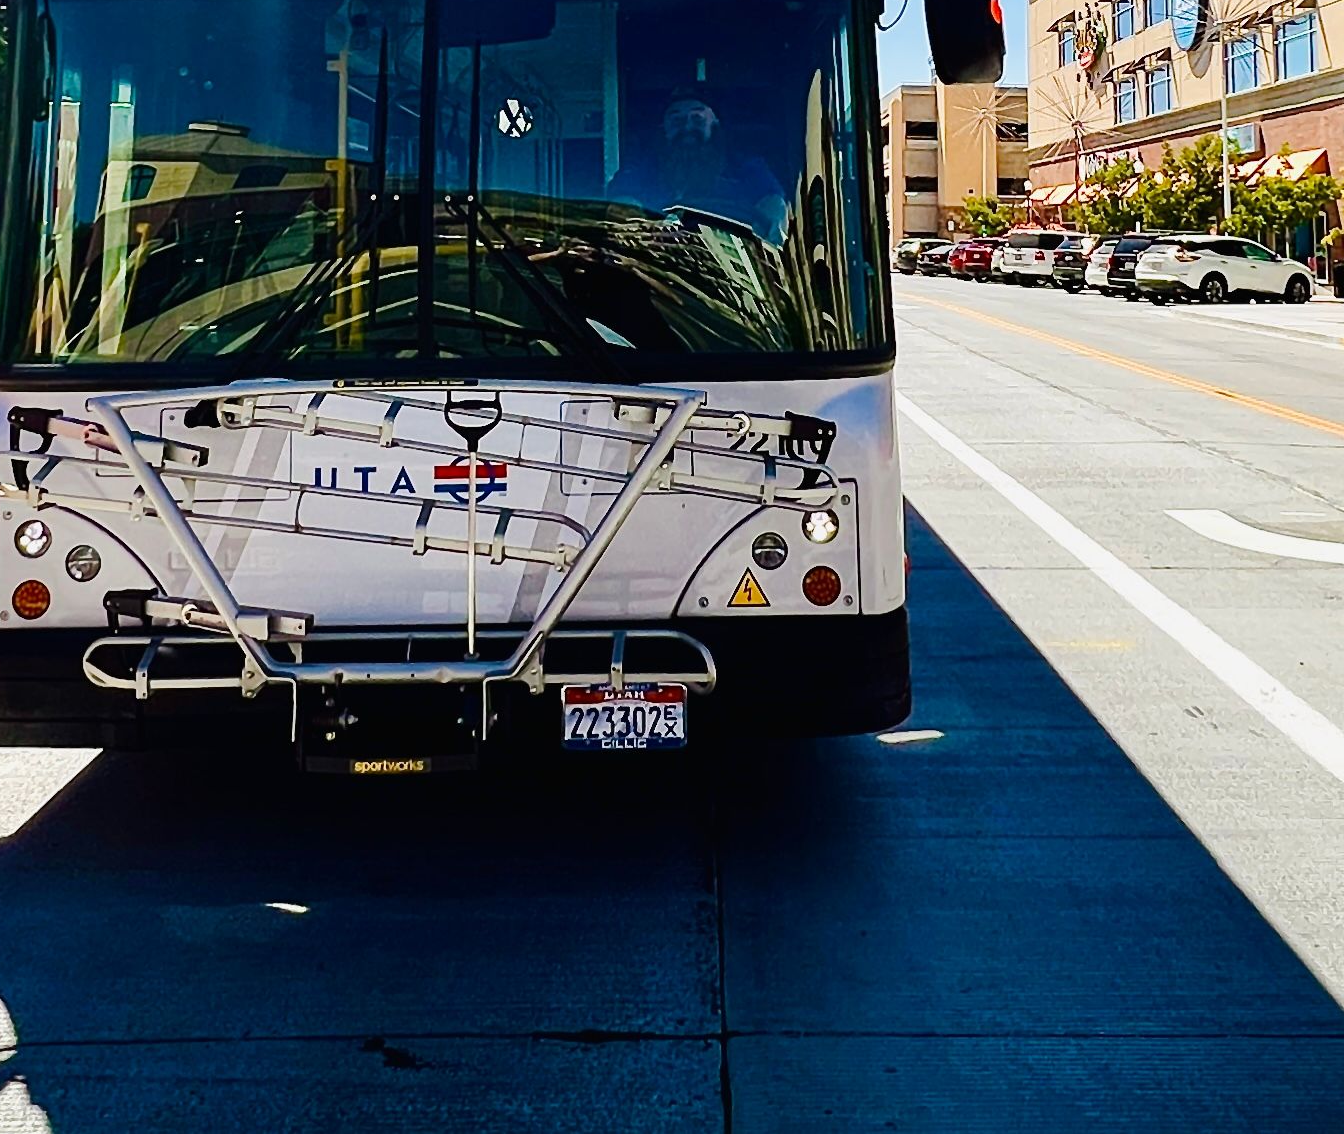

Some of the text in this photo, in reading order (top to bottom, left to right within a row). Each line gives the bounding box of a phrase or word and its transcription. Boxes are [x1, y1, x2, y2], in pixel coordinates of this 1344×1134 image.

[314, 466, 416, 494] UTA
[570, 706, 662, 739] 223302
[354, 759, 424, 774] sportworks
